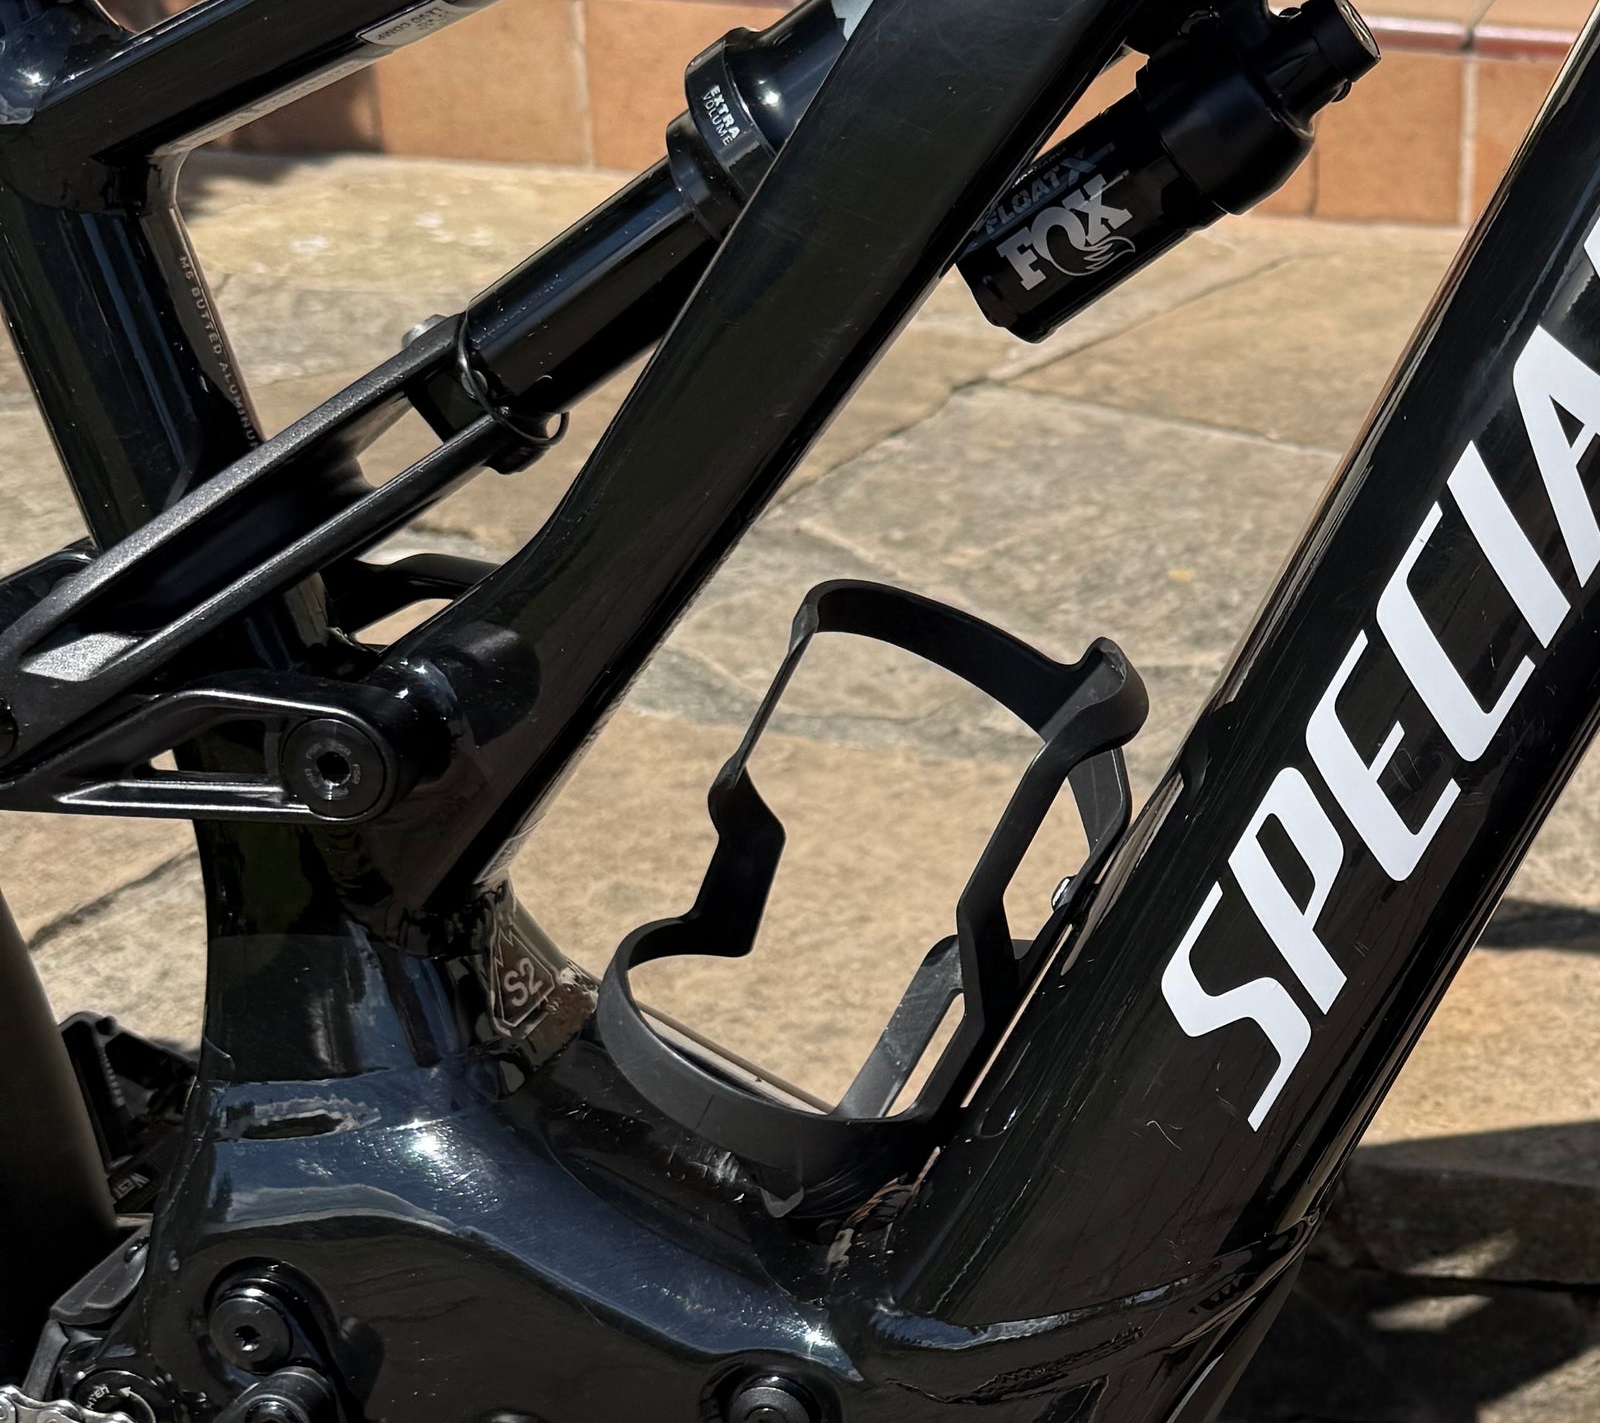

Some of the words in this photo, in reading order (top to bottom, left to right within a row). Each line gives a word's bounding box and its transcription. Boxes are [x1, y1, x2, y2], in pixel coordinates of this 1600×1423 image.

[703, 92, 733, 146] VOLUME
[710, 85, 741, 139] EXTRA
[996, 173, 1136, 291] FOX
[192, 287, 223, 355] BUTTED
[503, 957, 544, 1007] S2
